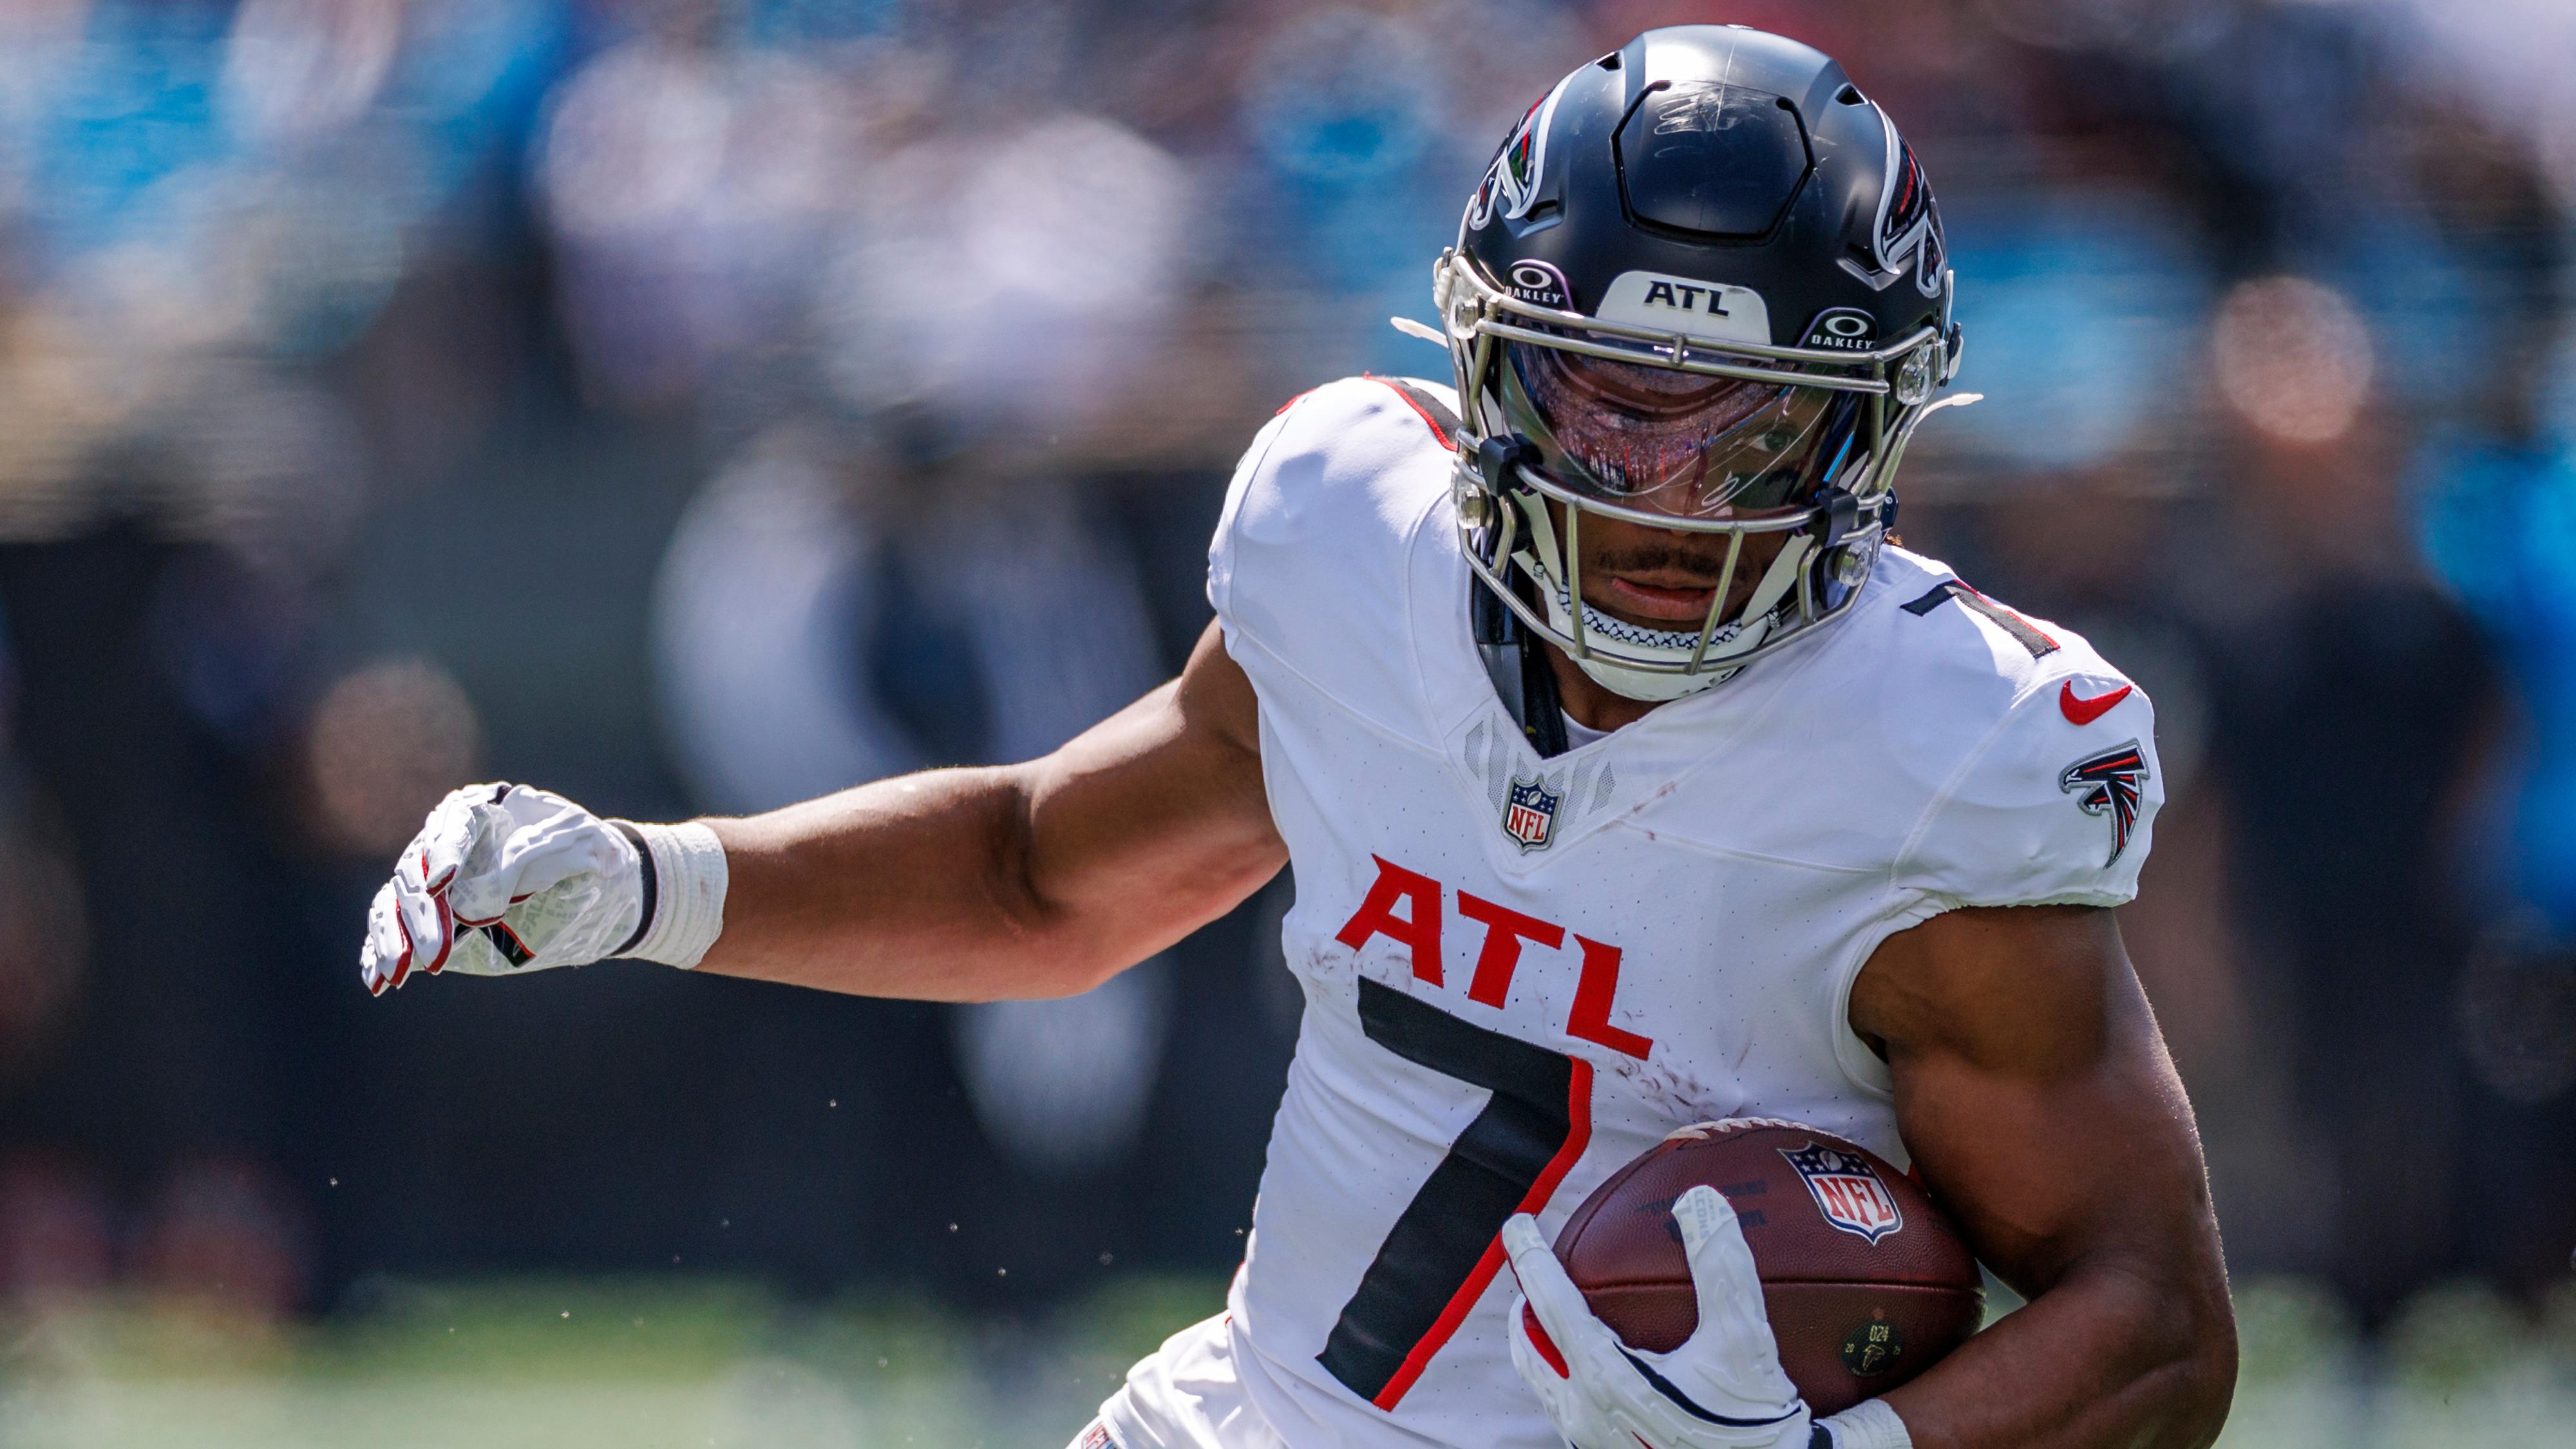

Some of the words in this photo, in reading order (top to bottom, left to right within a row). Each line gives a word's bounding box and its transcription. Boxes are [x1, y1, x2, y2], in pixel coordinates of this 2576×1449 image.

[1504, 286, 1561, 303] OAKLEY
[1644, 280, 1730, 317] ATL
[1812, 334, 1873, 350] OAKLEY
[1508, 806, 1545, 840] NFL
[1336, 853, 1654, 1061] ATL
[1314, 974, 1595, 1413] 7
[1813, 1177, 1894, 1227] NFL
[1870, 1325, 1889, 1341] 024
